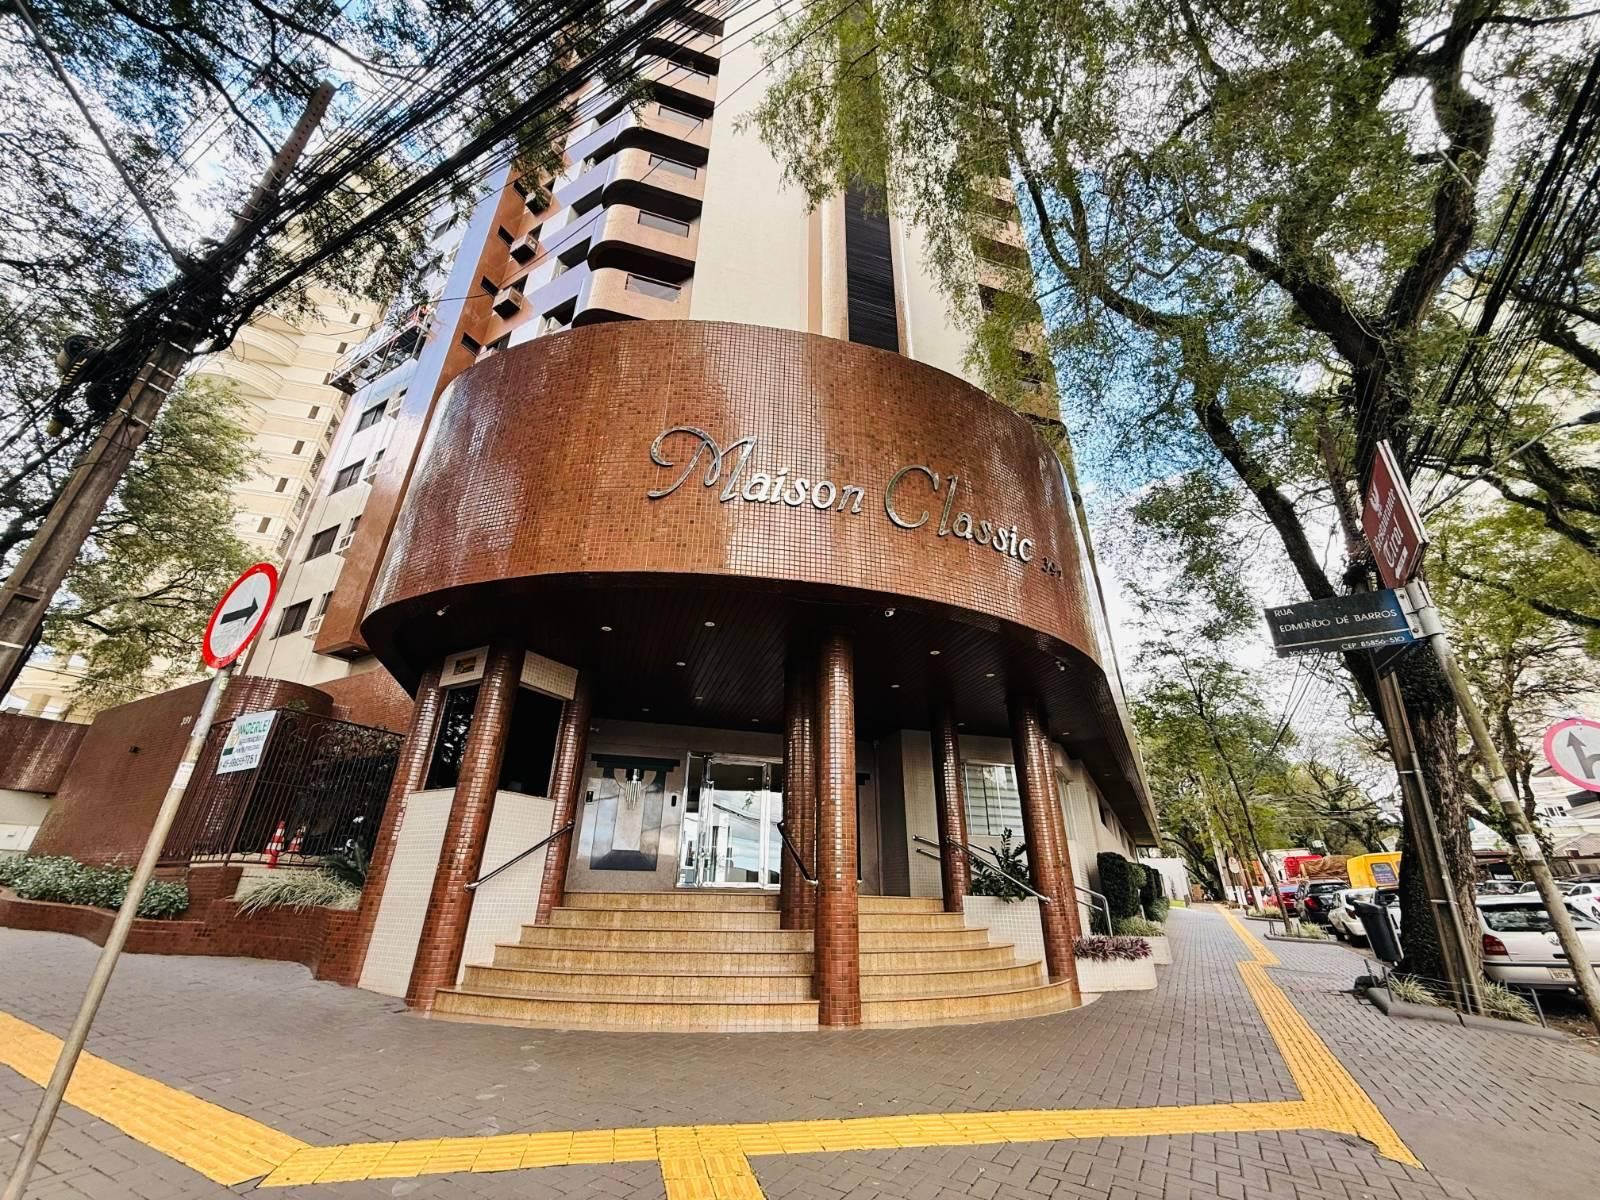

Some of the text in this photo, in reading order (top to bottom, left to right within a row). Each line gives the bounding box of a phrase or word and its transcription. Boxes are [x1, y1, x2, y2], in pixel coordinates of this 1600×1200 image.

[648, 425, 1035, 562] Maison Classic
[1274, 608, 1294, 617] RUA
[1279, 609, 1398, 633] EDMUNDO DE BARROS
[1341, 642, 1357, 650] CEP
